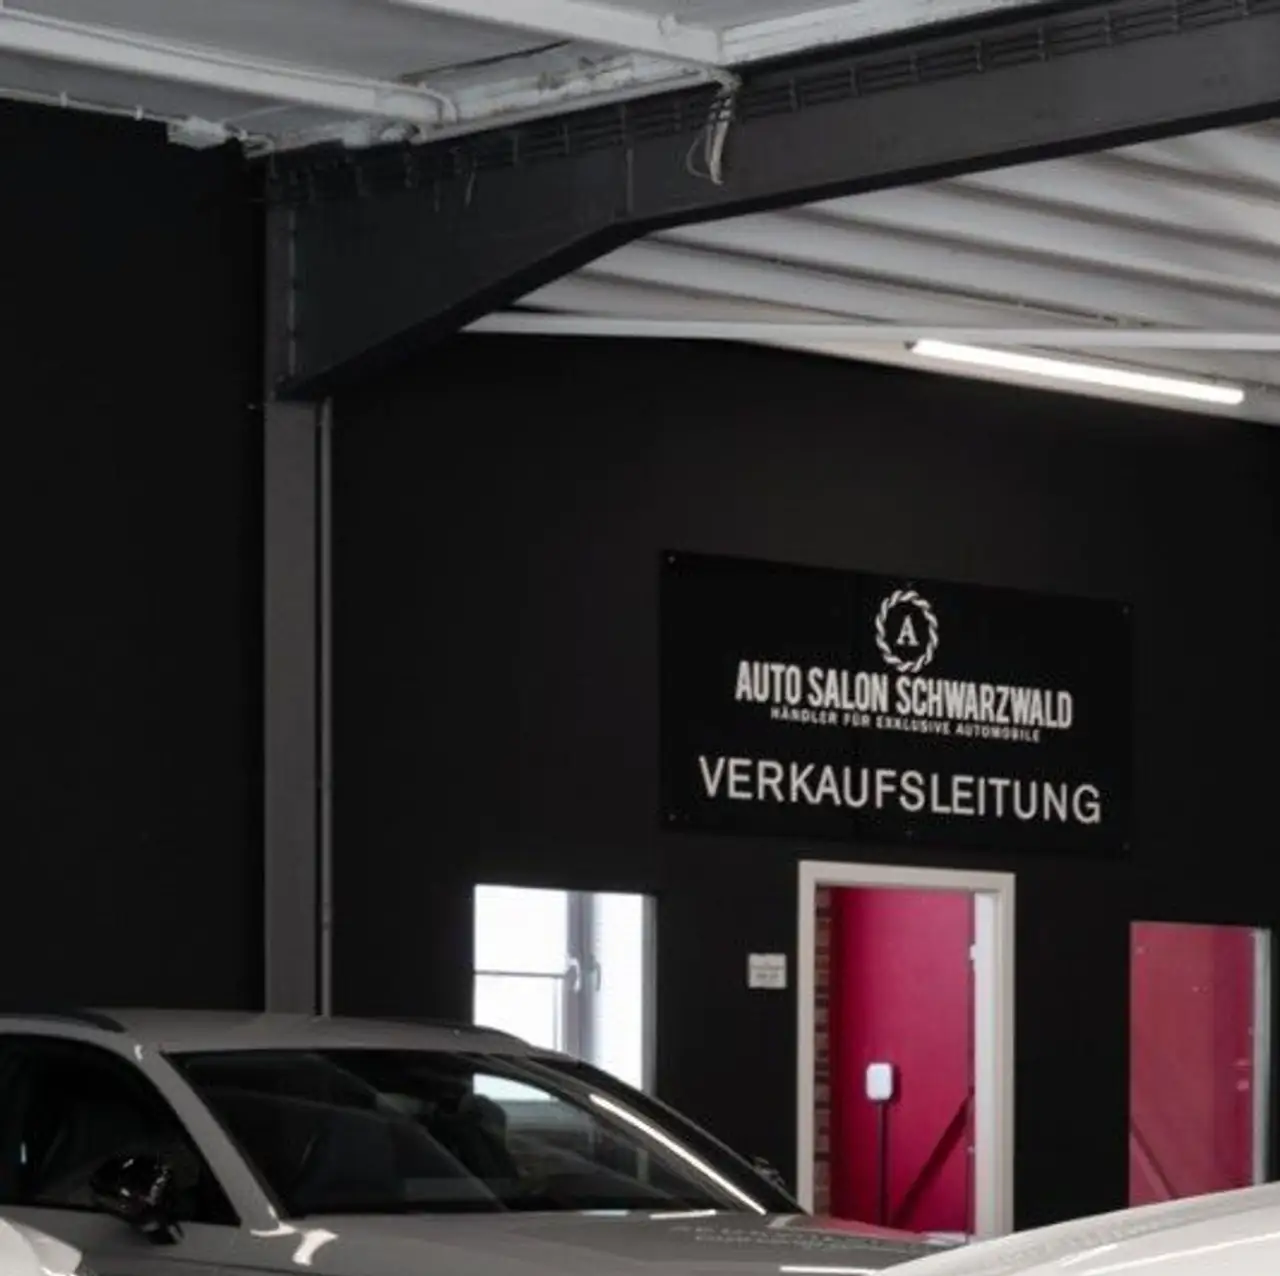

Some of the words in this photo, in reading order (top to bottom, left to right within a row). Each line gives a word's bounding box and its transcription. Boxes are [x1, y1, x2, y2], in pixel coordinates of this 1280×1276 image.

[896, 614, 919, 647] A
[735, 660, 801, 706] AUTO
[807, 667, 888, 713] SALON
[896, 675, 1072, 729] SCHWARZWALD
[770, 705, 838, 726] HÄNDLER
[844, 711, 871, 728] FÜR
[876, 715, 951, 736] EXKLUSIVE
[955, 722, 1040, 743] AUTOMOBILE
[699, 755, 1101, 824] VERKAUFSLEITUNG
